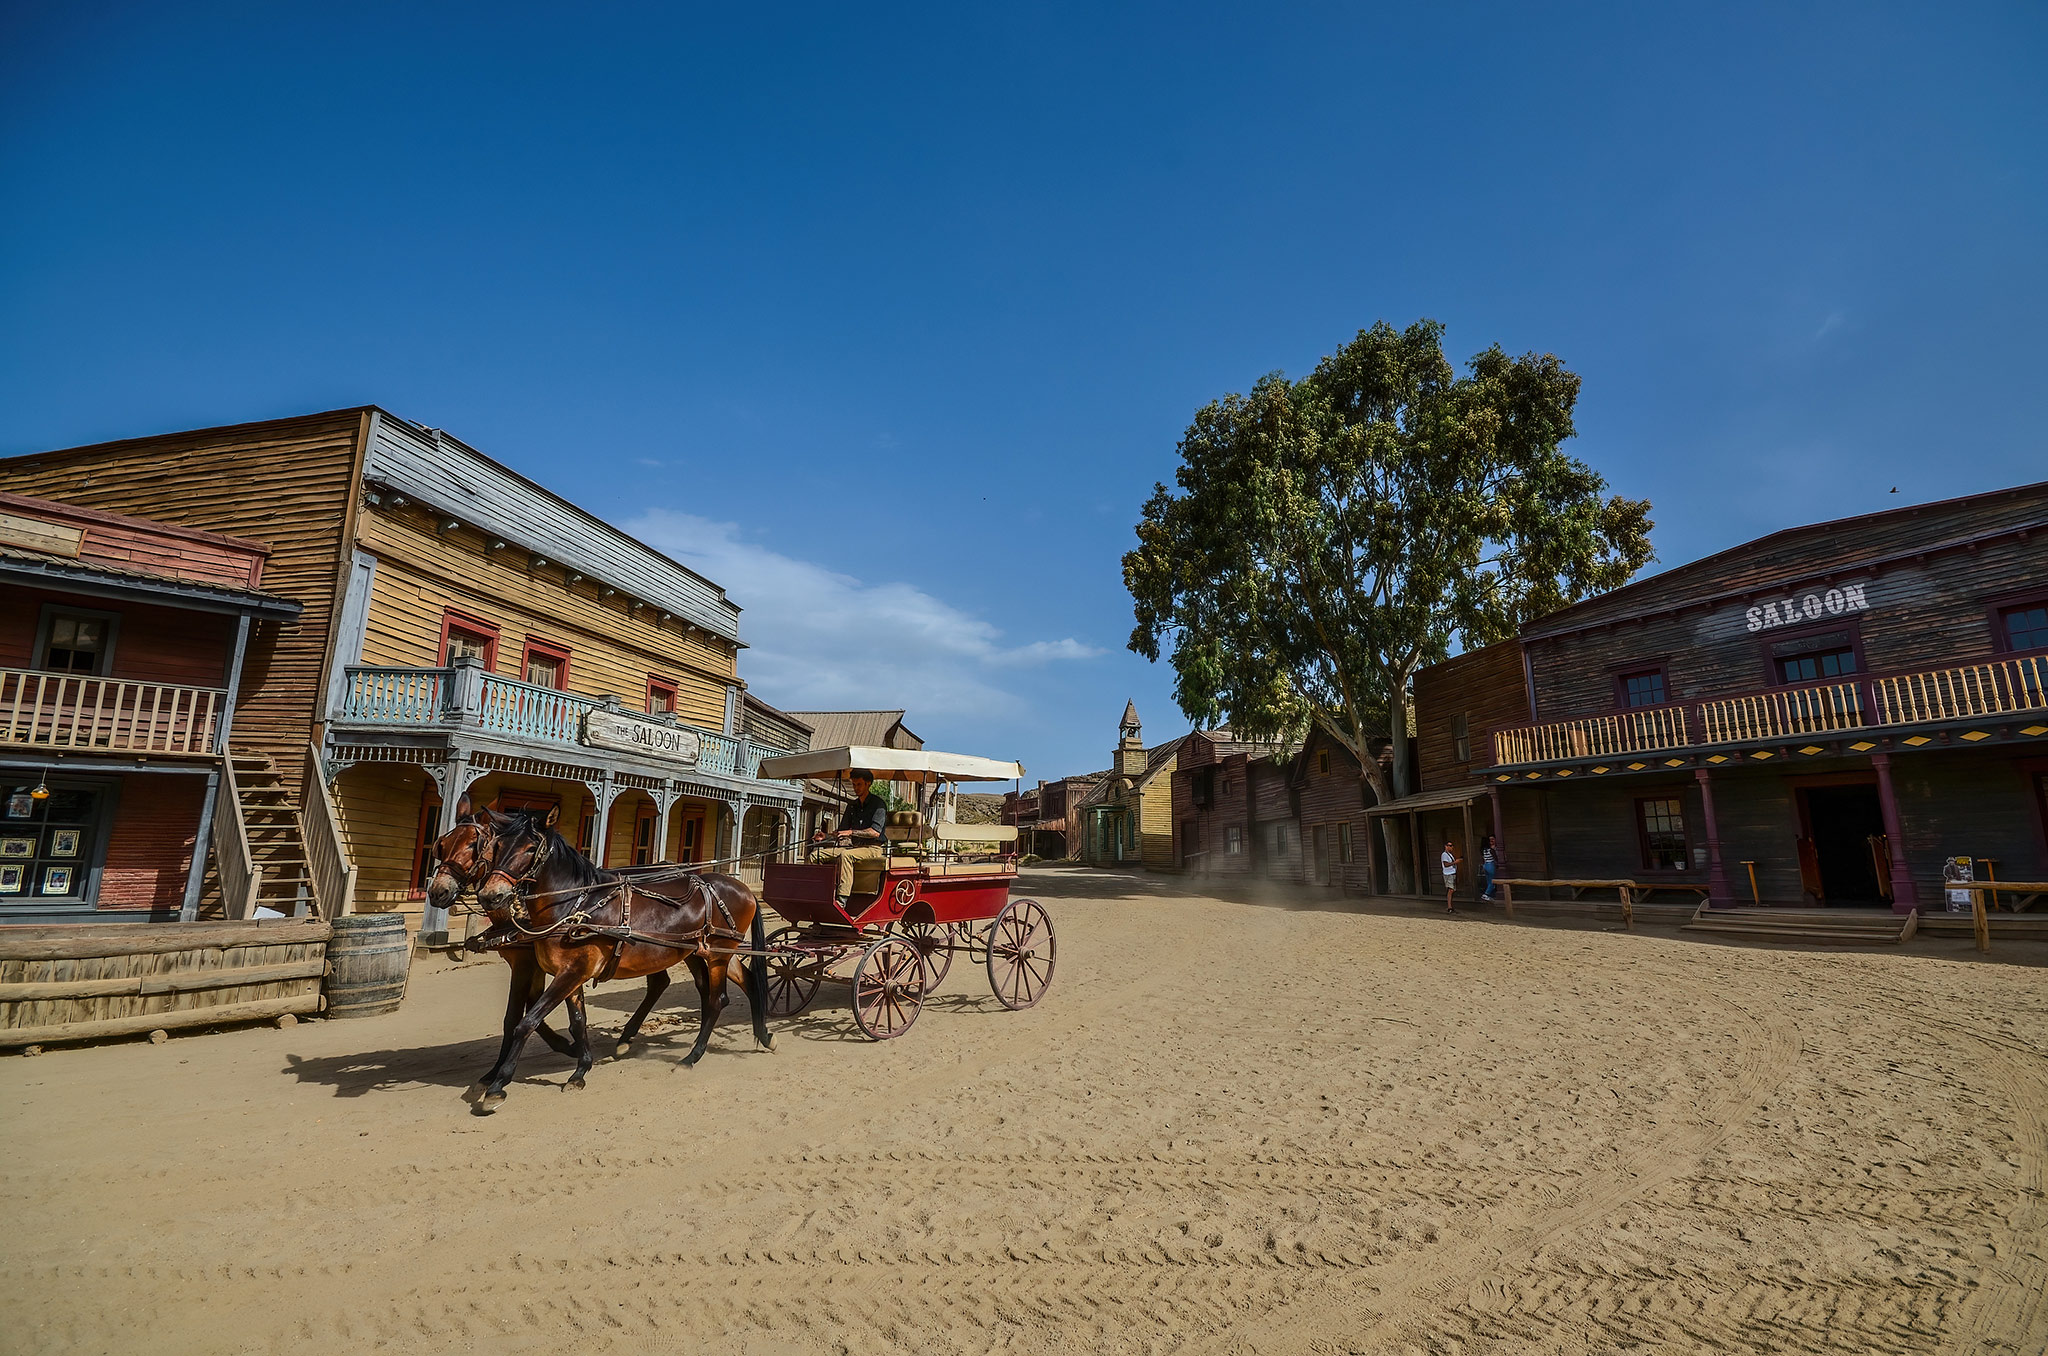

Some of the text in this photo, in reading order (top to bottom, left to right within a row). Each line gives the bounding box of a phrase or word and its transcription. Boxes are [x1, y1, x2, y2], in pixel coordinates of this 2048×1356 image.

[1746, 583, 1870, 632] SALOON
[616, 724, 681, 751] THE SALOON
